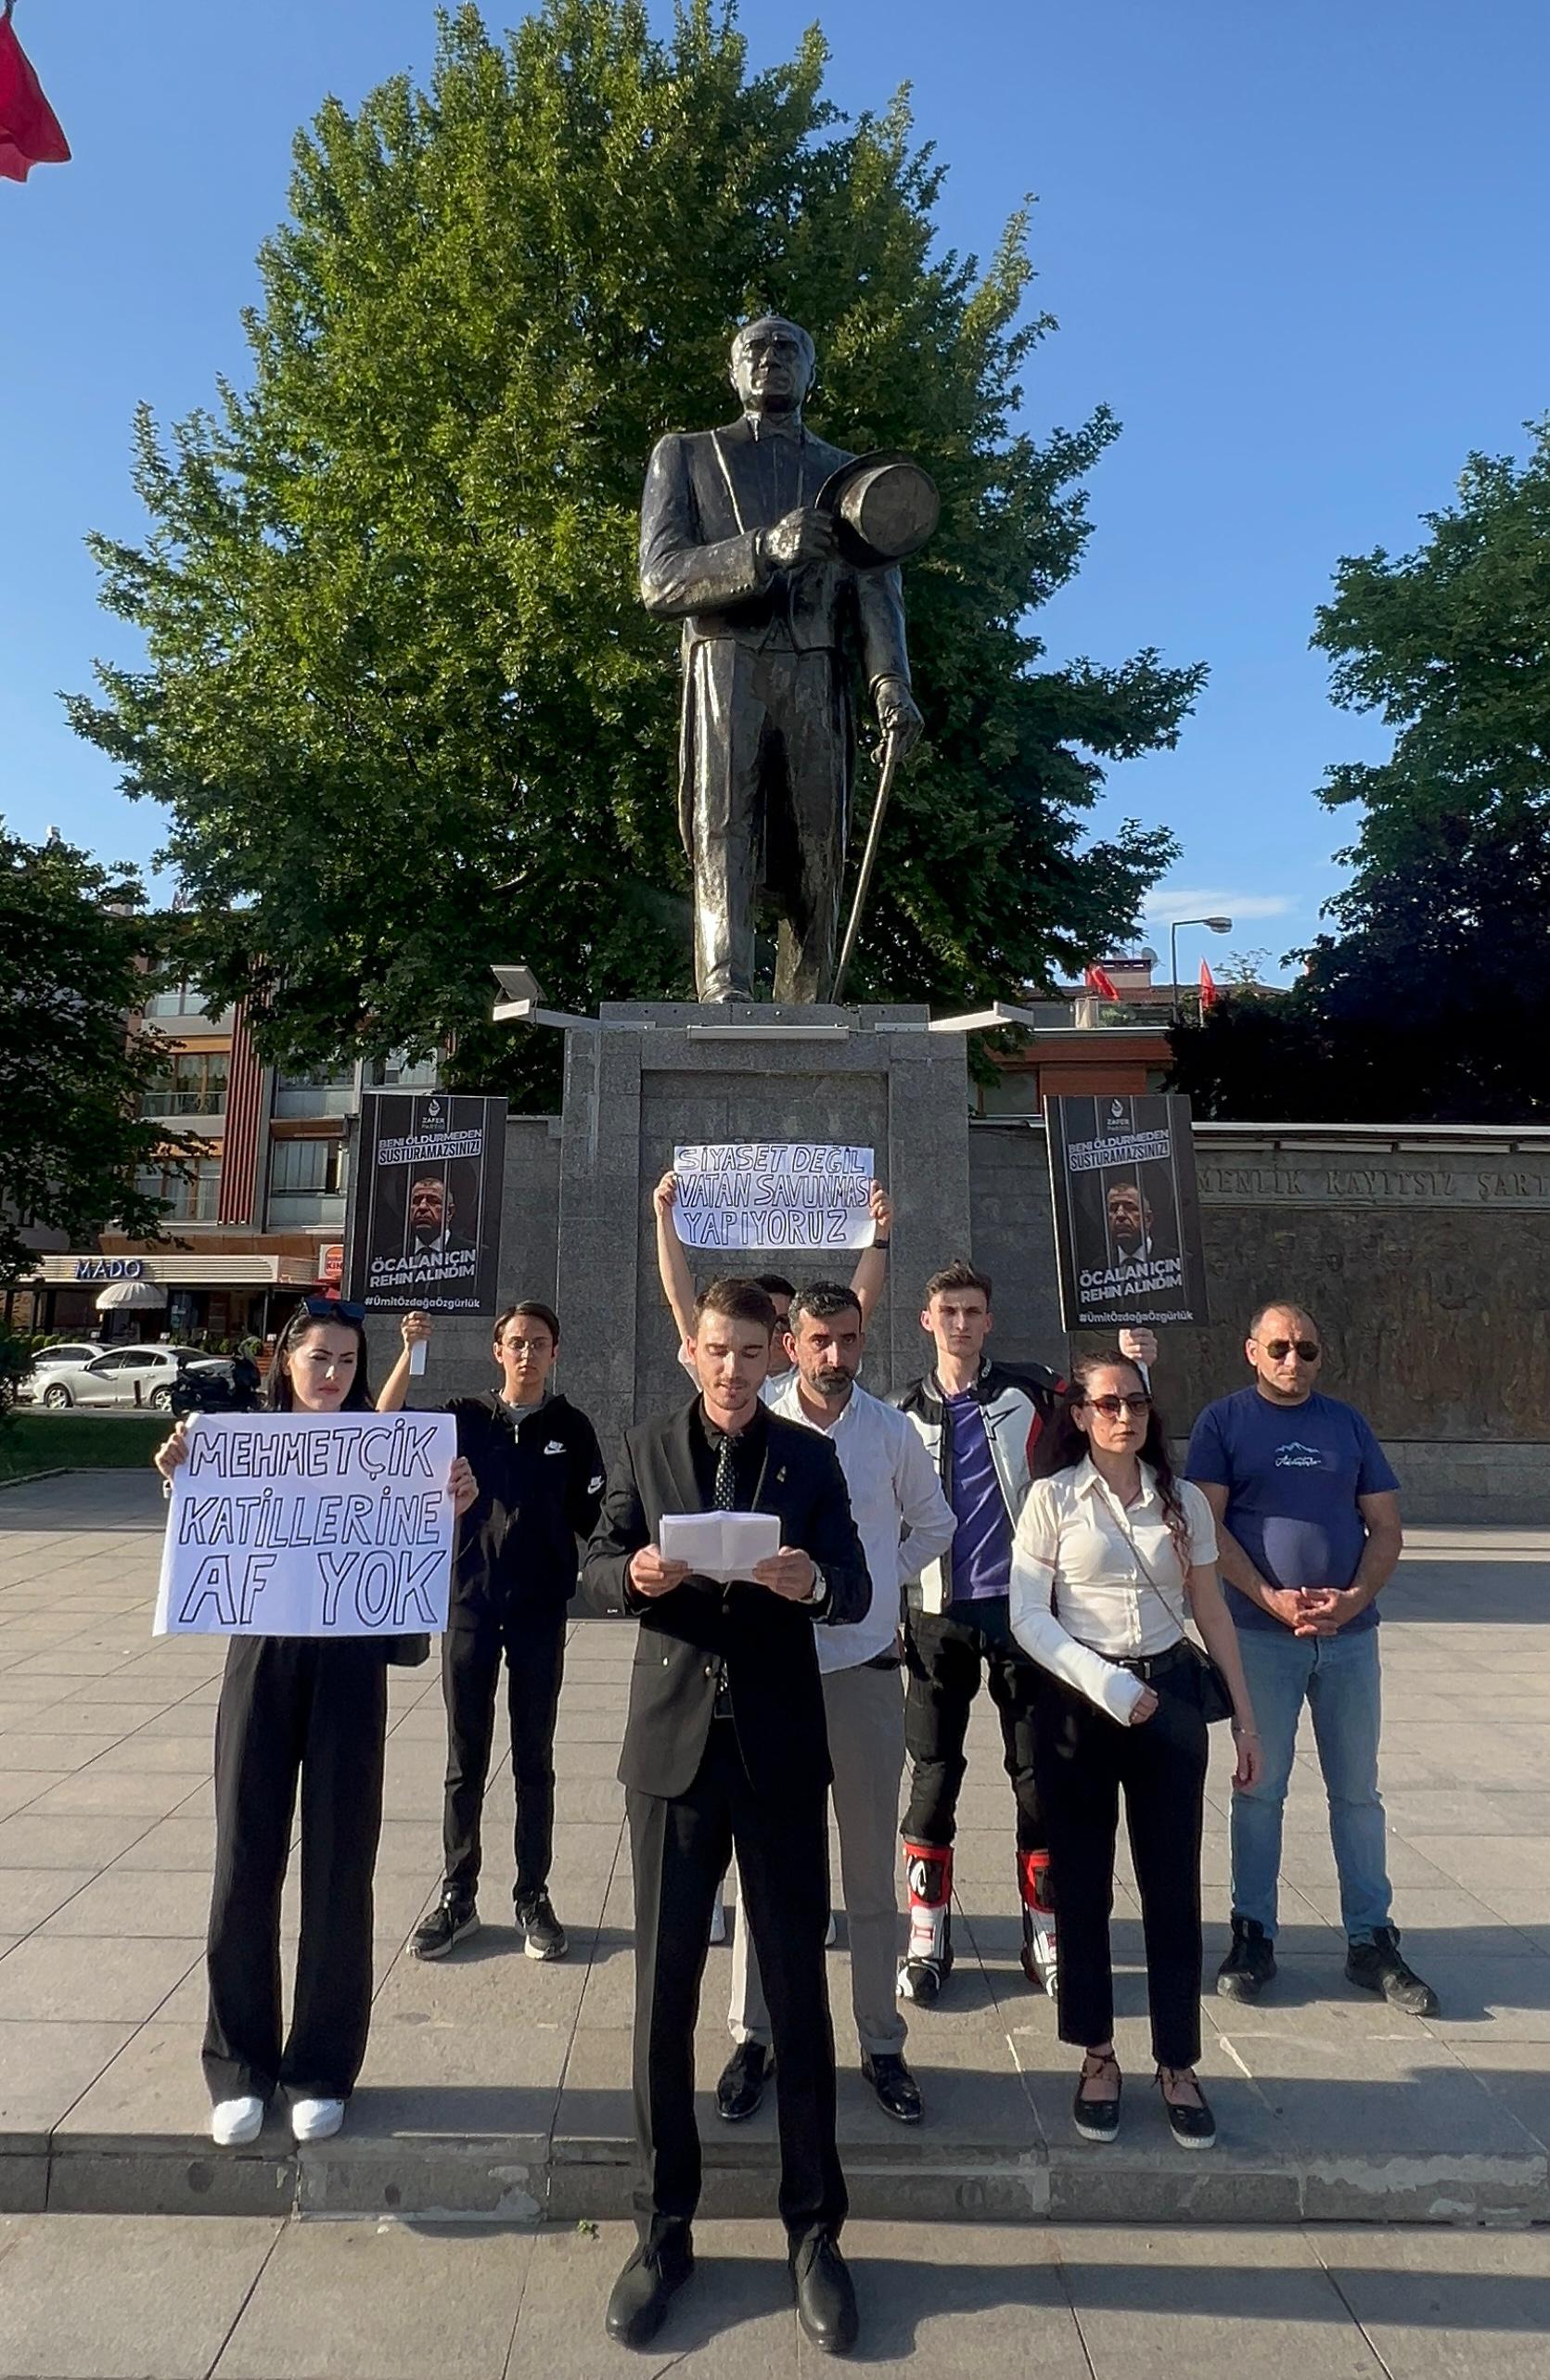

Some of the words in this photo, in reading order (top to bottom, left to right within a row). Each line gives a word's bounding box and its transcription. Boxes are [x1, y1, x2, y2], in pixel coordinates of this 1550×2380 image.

[678, 1145, 788, 1172] SİYASET
[791, 1146, 865, 1173] DEĞİL
[675, 1173, 751, 1208] VATAN
[684, 1209, 848, 1246] YAPIYORUZ
[75, 1258, 142, 1280] MADO
[371, 1255, 442, 1273] ÖCALAN
[1079, 1263, 1148, 1287] ÖCALAN
[189, 1417, 438, 1481] MEHMETÇİK
[179, 1486, 442, 1547] KATİLLERİNE
[179, 1554, 277, 1625] AF
[317, 1550, 447, 1627] YOK
